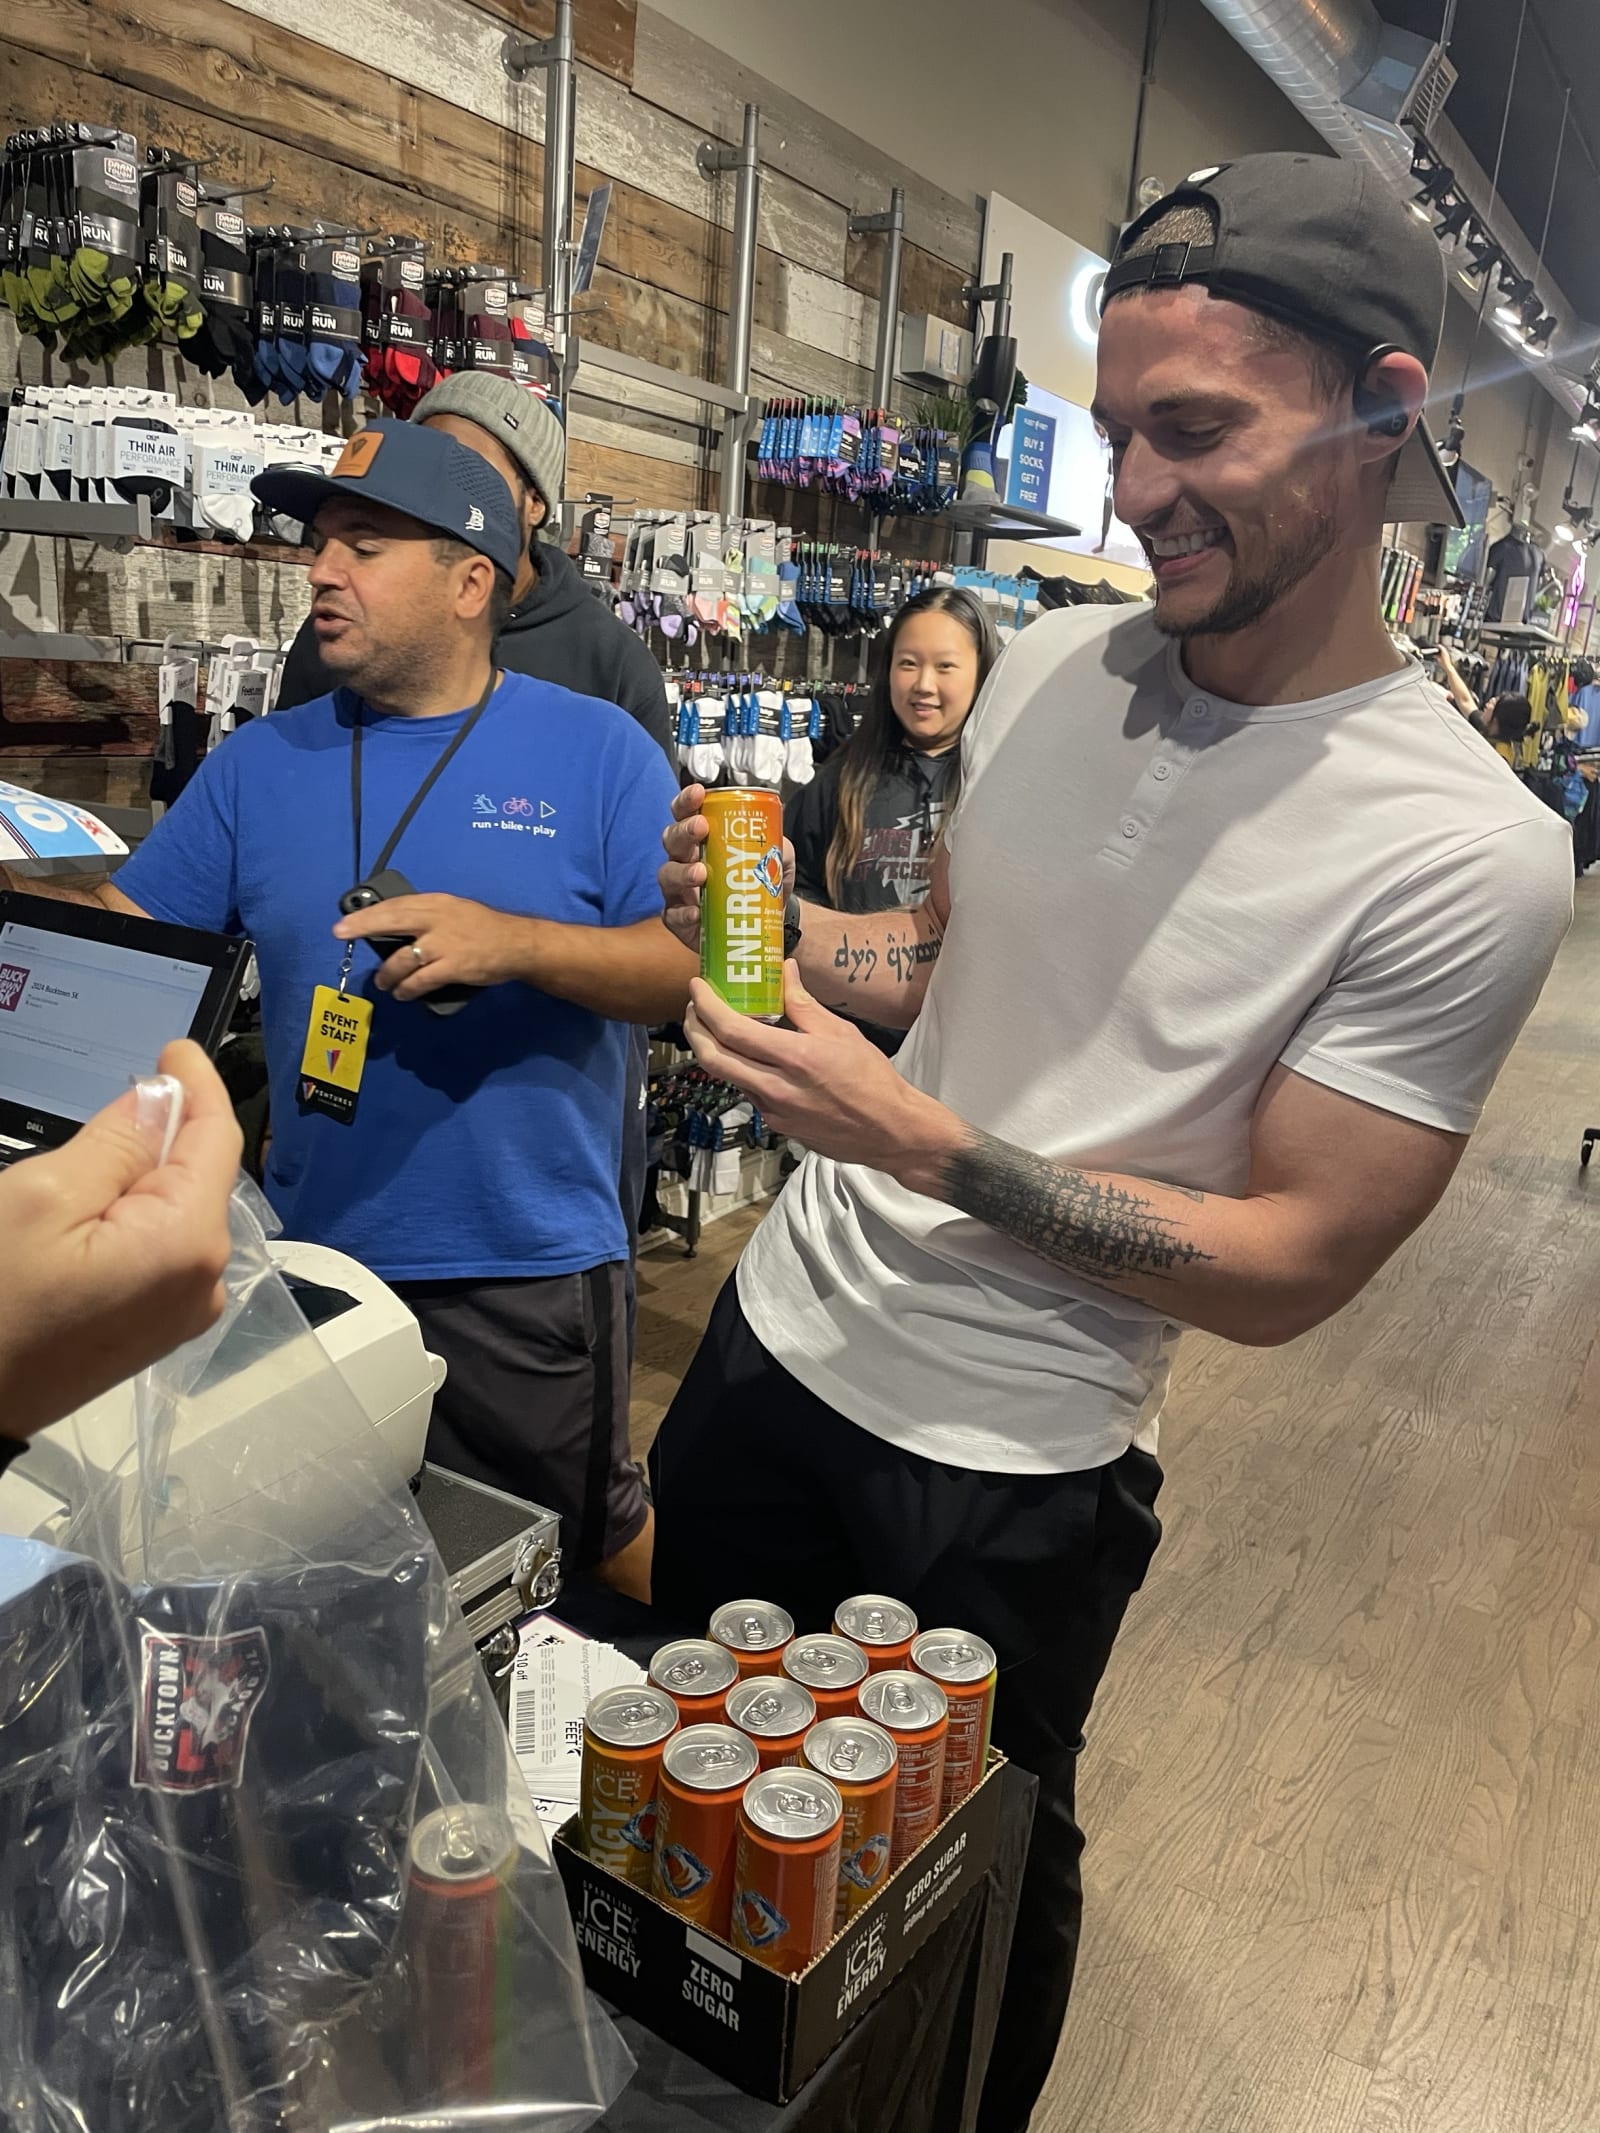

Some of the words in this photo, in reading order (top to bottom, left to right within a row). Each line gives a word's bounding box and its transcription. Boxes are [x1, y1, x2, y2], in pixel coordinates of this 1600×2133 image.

[35, 227, 49, 243] RU
[83, 225, 111, 242] RUN
[168, 252, 187, 268] RUN
[262, 314, 275, 326] RU
[312, 315, 337, 330] RUN
[390, 324, 413, 338] RUN
[475, 349, 497, 361] RUN
[128, 439, 156, 454] THIN
[158, 446, 176, 457] AIR
[1023, 436, 1038, 449] BUY
[1039, 440, 1044, 452] 3
[120, 450, 182, 468] PERFORMANCE
[213, 459, 239, 474] THIN
[240, 464, 256, 476] AIR
[1019, 453, 1045, 472] SOCKS,
[206, 470, 250, 483] PERFORMA
[1021, 472, 1036, 484] GET
[1019, 489, 1038, 503] FREE
[584, 562, 601, 574] RUN
[723, 809, 764, 817] SPARKLING
[472, 821, 492, 829] run
[500, 820, 524, 831] bike
[532, 824, 557, 838] play
[722, 816, 767, 842] ICE
[726, 844, 762, 983] ENERGY
[0, 967, 26, 984] BUCK
[32, 982, 45, 992] 2024
[45, 984, 71, 998] Bucktown
[323, 1010, 359, 1031] EVENT
[320, 1024, 357, 1045] STAFF
[516, 1669, 528, 1681] off
[151, 1649, 180, 1772] BUCKTOWN
[565, 1721, 578, 1746] FEET
[589, 1797, 632, 1876] RGY
[904, 1875, 931, 1911] ZERO
[933, 1832, 967, 1880] SUGAR
[583, 1880, 633, 1915] SPARKLING
[579, 1889, 637, 1944] ICE
[575, 1921, 641, 1979] ENERGY
[842, 1921, 885, 1986] ICE
[690, 1959, 734, 2003] ZERO
[836, 1947, 888, 2020] ENERGY
[682, 1979, 740, 2033] SUGAR
